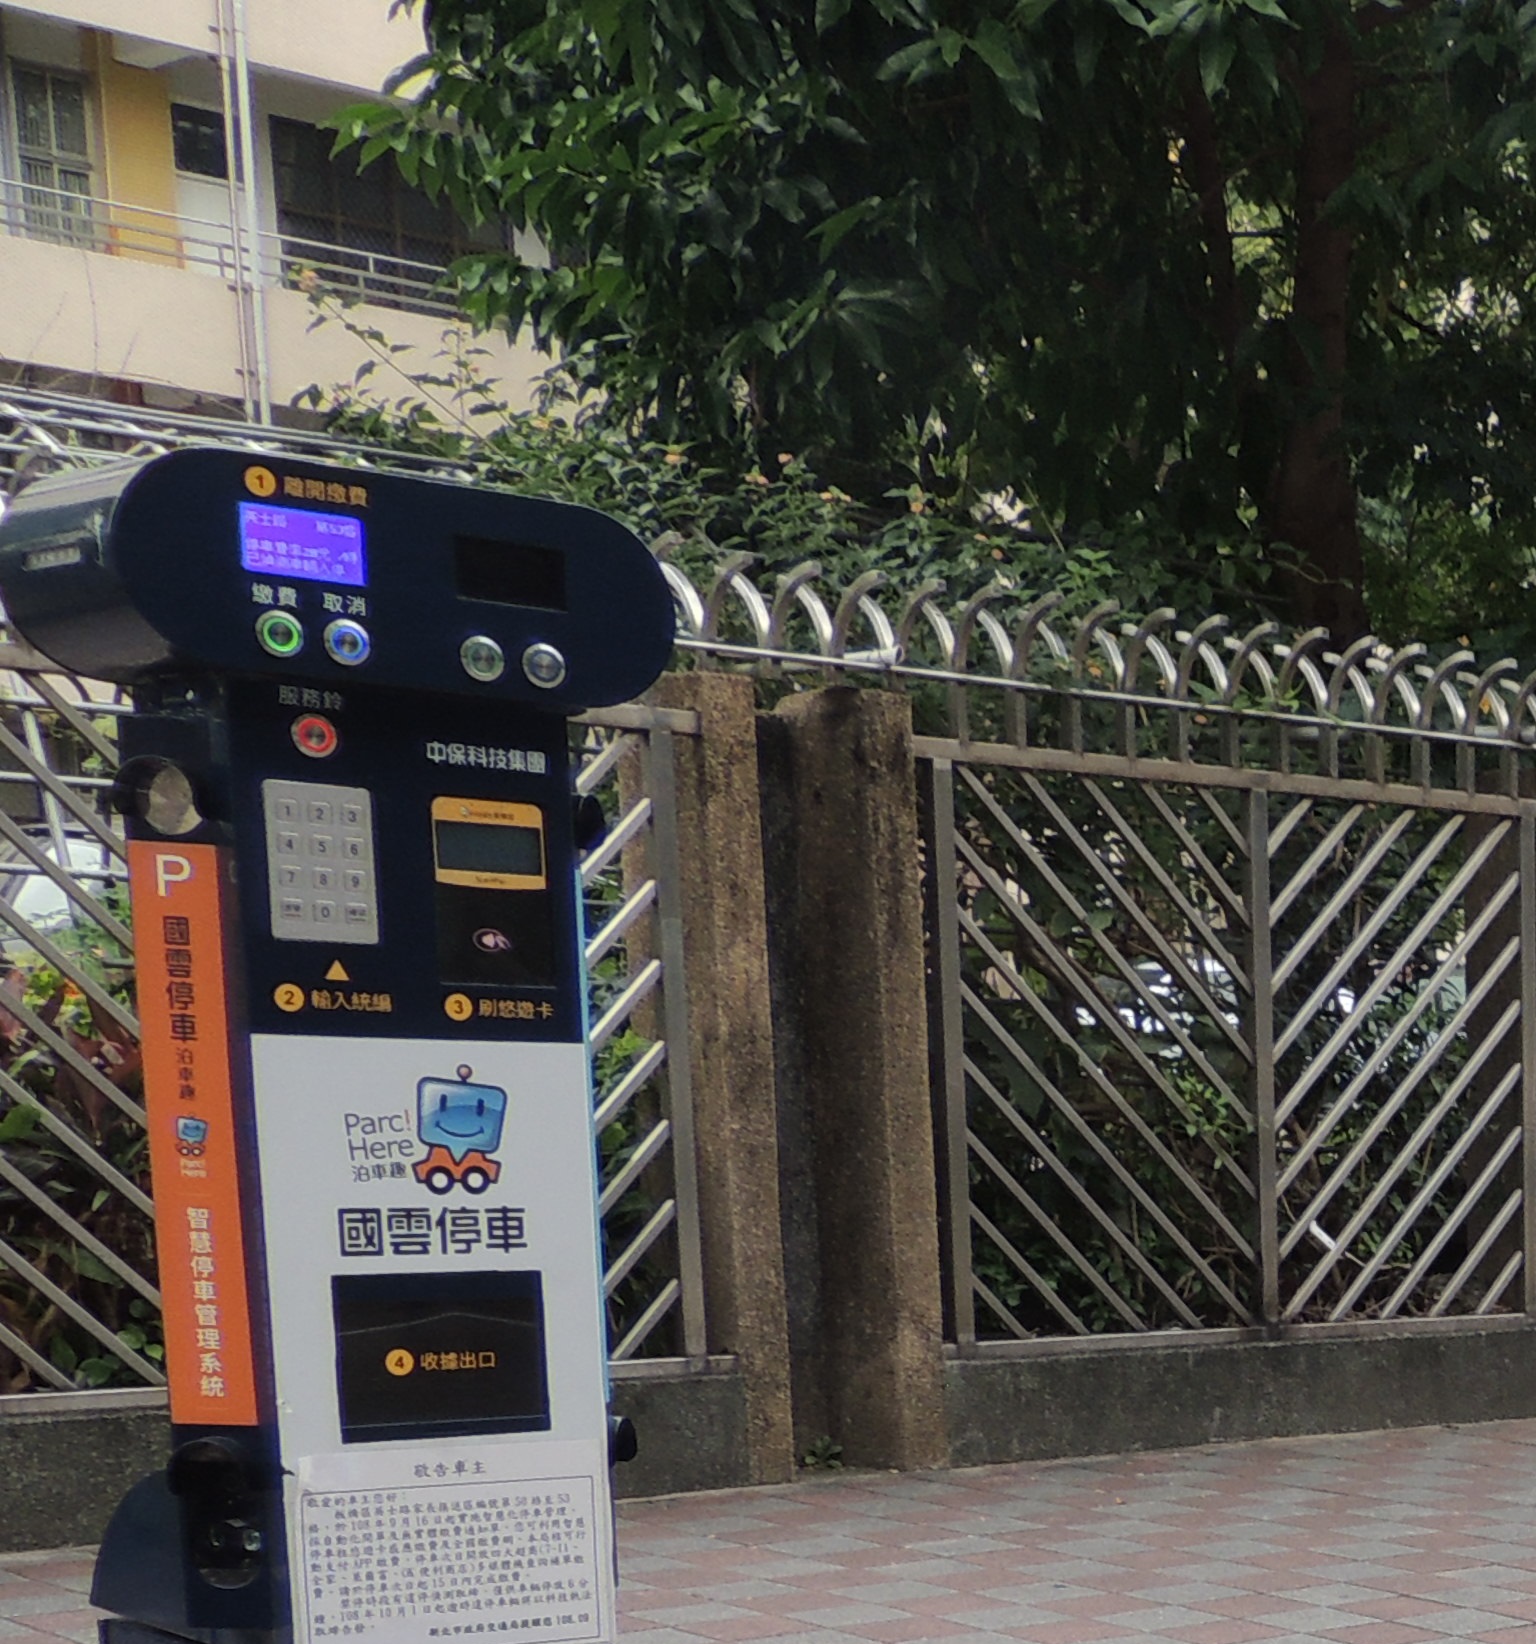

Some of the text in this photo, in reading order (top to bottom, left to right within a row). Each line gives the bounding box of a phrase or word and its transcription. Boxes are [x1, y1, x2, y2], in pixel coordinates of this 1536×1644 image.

[251, 581, 367, 616] 繳費 取消
[278, 684, 343, 711] 服務鈴
[425, 740, 546, 775] 中保科技集團
[284, 805, 357, 822] 1 2 3
[284, 838, 359, 855] 4 5 6
[155, 853, 192, 897] P
[286, 871, 361, 888] 7 8 9
[321, 906, 330, 918] 0
[162, 915, 199, 1043] 國雲停車
[310, 988, 393, 1013] 輸入統編
[343, 1109, 413, 1137] Parc!
[347, 1136, 415, 1162] Here
[351, 1161, 408, 1183] 泊車趣
[337, 1205, 529, 1258] 國雲停車
[186, 1206, 225, 1398] 智慧停車管理系統
[420, 1350, 497, 1371] 收據出口
[413, 1460, 487, 1479] 敬告車主
